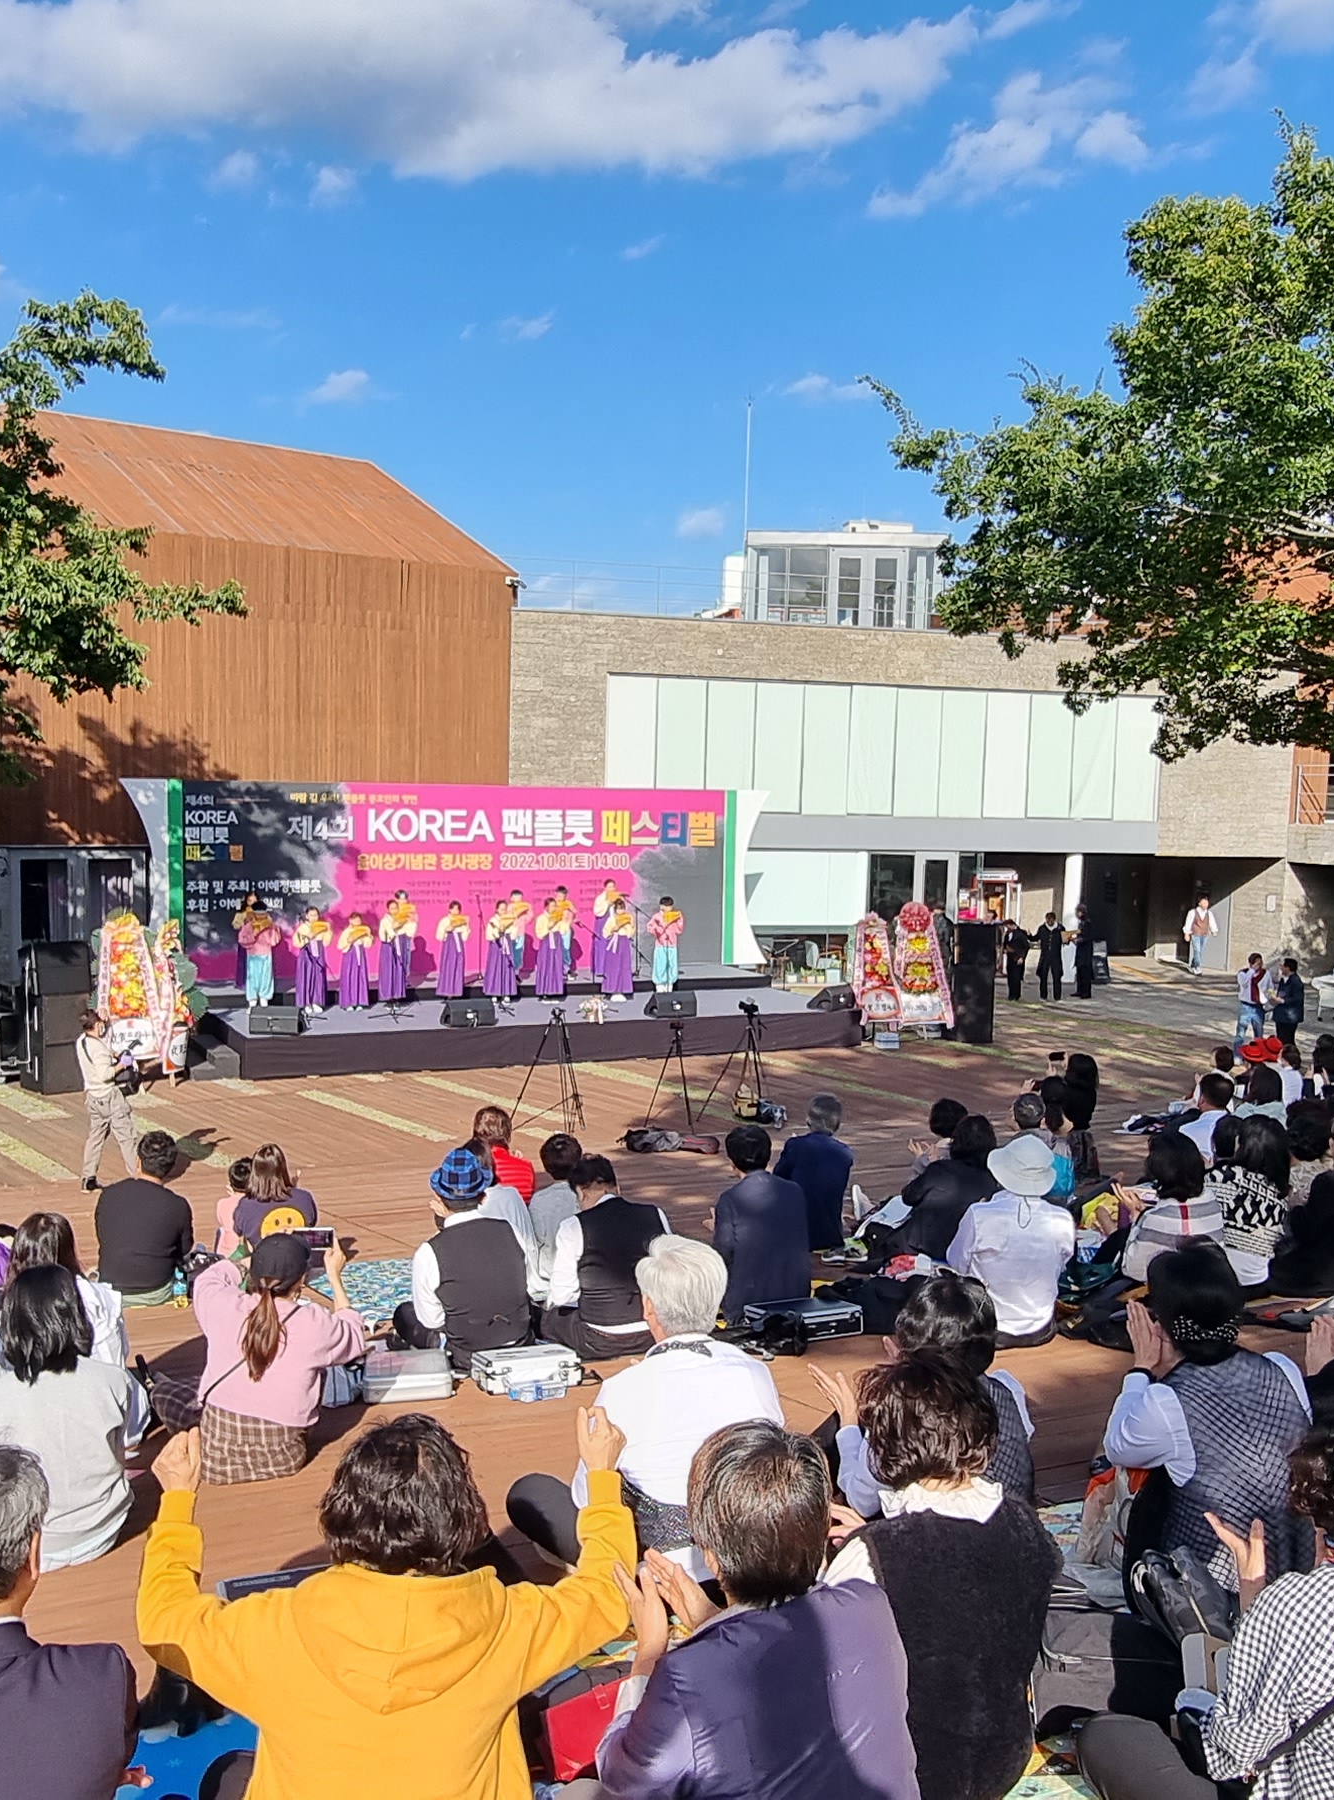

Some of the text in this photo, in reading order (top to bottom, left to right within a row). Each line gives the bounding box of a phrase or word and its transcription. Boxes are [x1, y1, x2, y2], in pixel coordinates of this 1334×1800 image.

[185, 794, 215, 806] 제4회
[185, 810, 238, 825] KOREA
[185, 826, 229, 844] 팬플룻
[287, 808, 715, 847] 제4회 KOREA 팬플룻 페스티벌
[185, 844, 244, 862] 페스벌
[186, 881, 209, 895] 주관
[213, 881, 223, 894] 및
[227, 880, 249, 893] 주최
[186, 899, 209, 912] 후원
